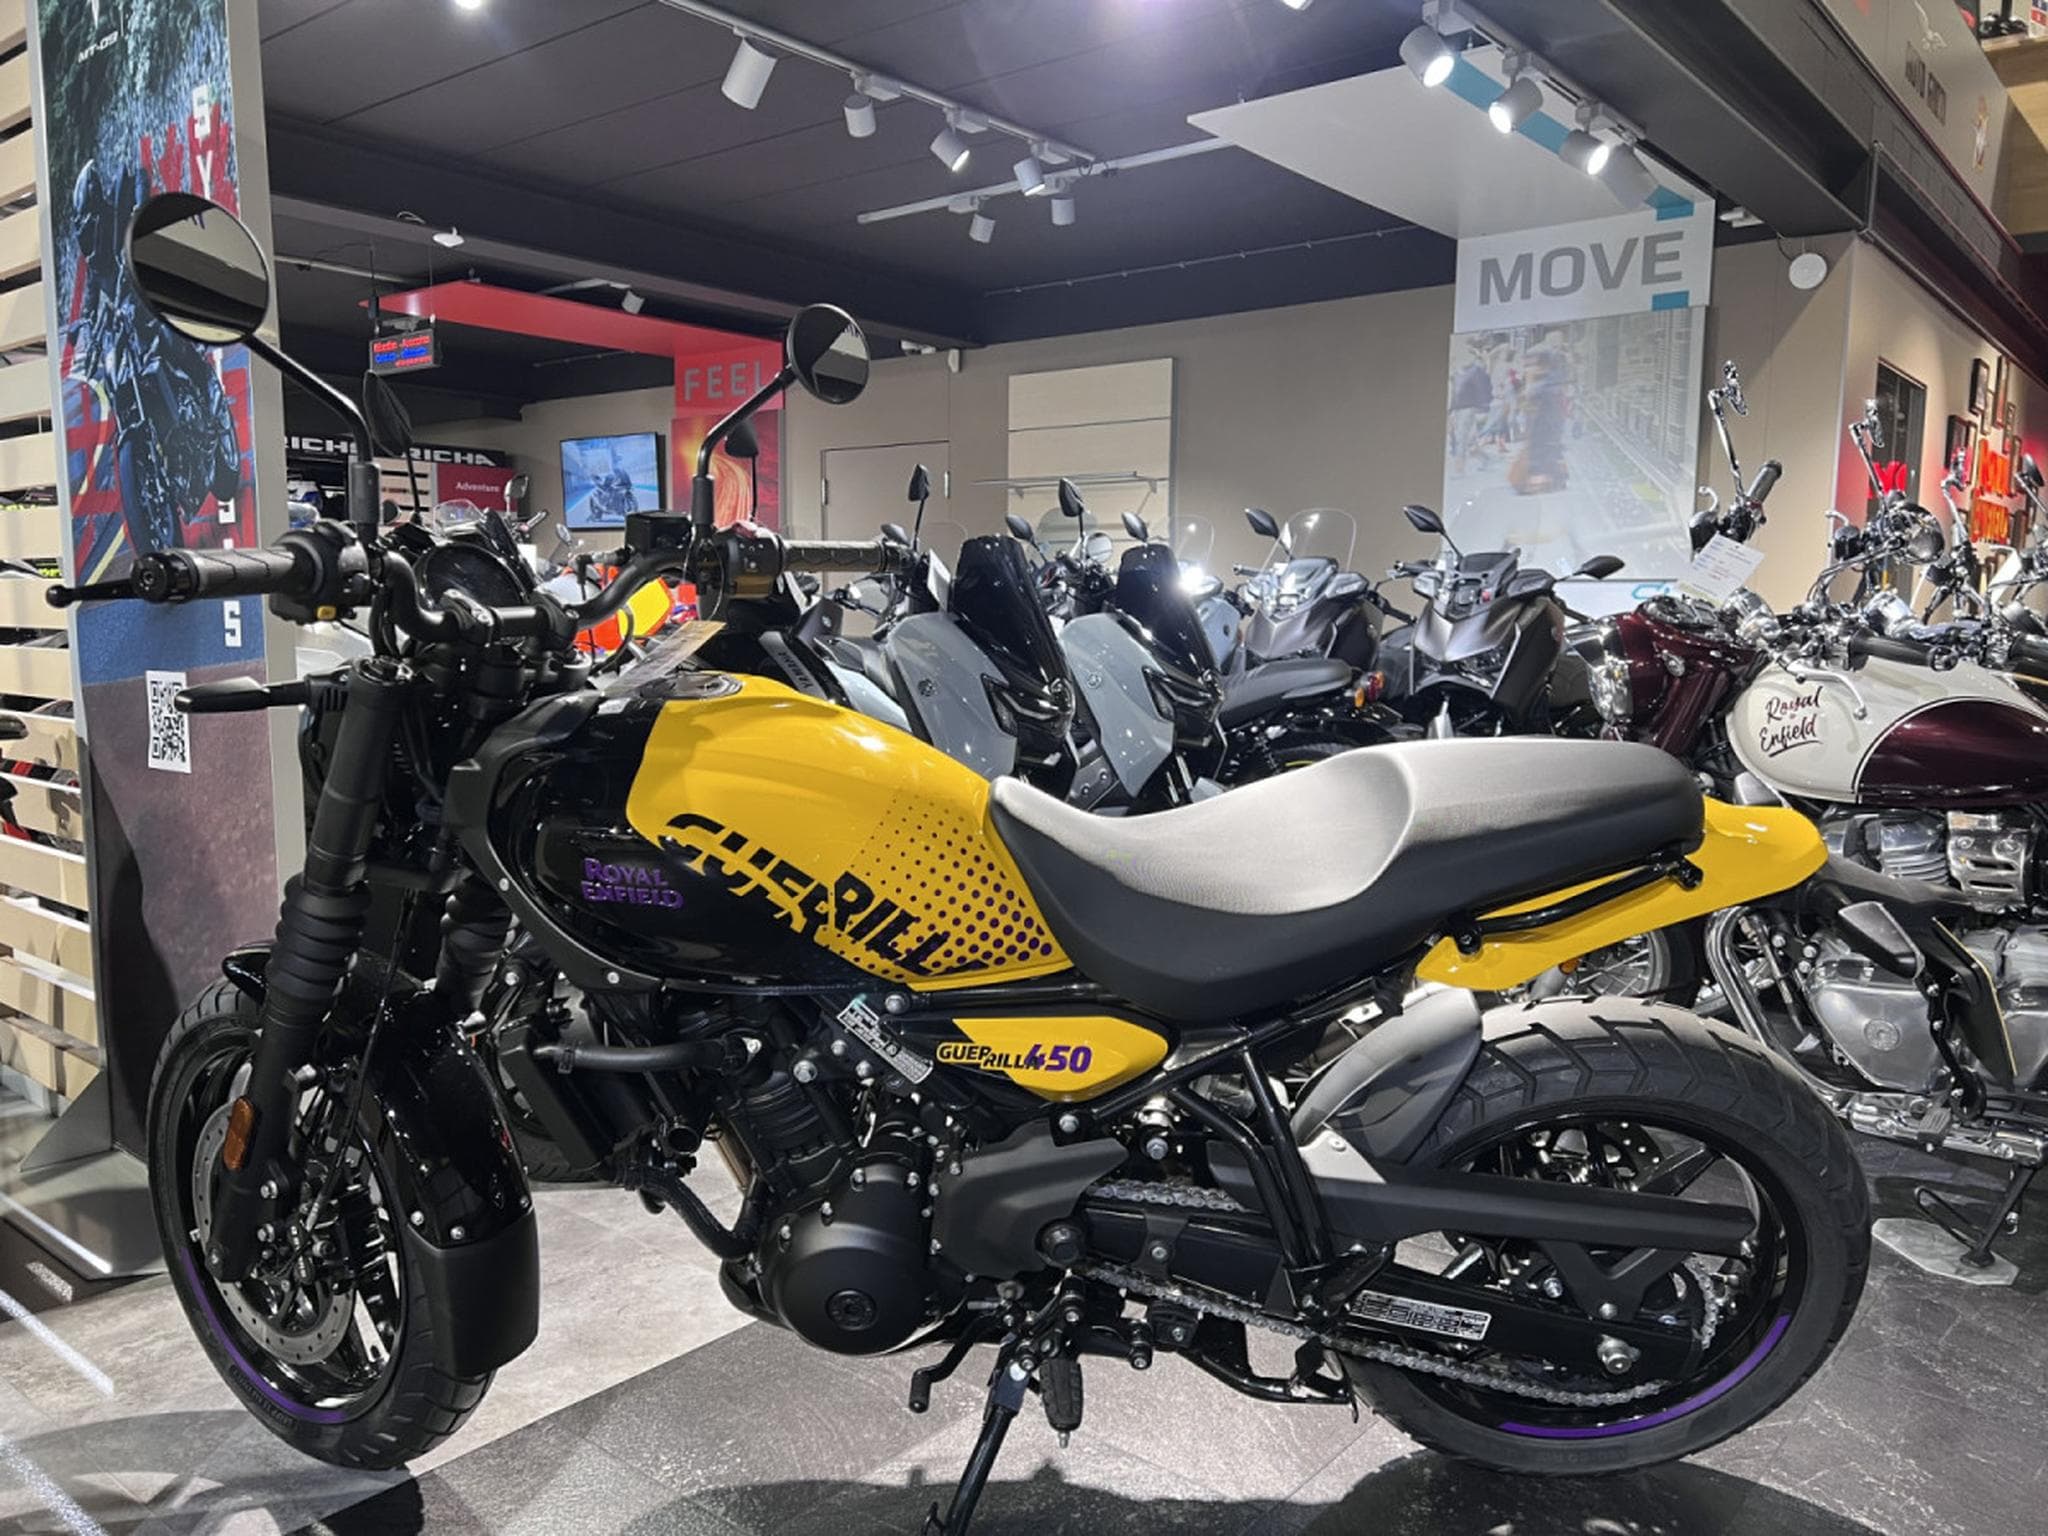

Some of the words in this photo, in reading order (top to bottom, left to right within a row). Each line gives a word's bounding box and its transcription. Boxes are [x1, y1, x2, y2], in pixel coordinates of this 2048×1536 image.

[78, 31, 119, 64] MT-09
[1479, 231, 1684, 305] MOVE
[684, 362, 766, 401] FEEL
[401, 447, 496, 466] RICHA
[455, 481, 500, 493] Adventure
[1765, 685, 1823, 724] Royal
[1760, 713, 1818, 752] Enfield
[585, 858, 668, 886] ROYAL
[581, 881, 684, 908] ENFIELD
[1024, 1044, 1092, 1073] 450
